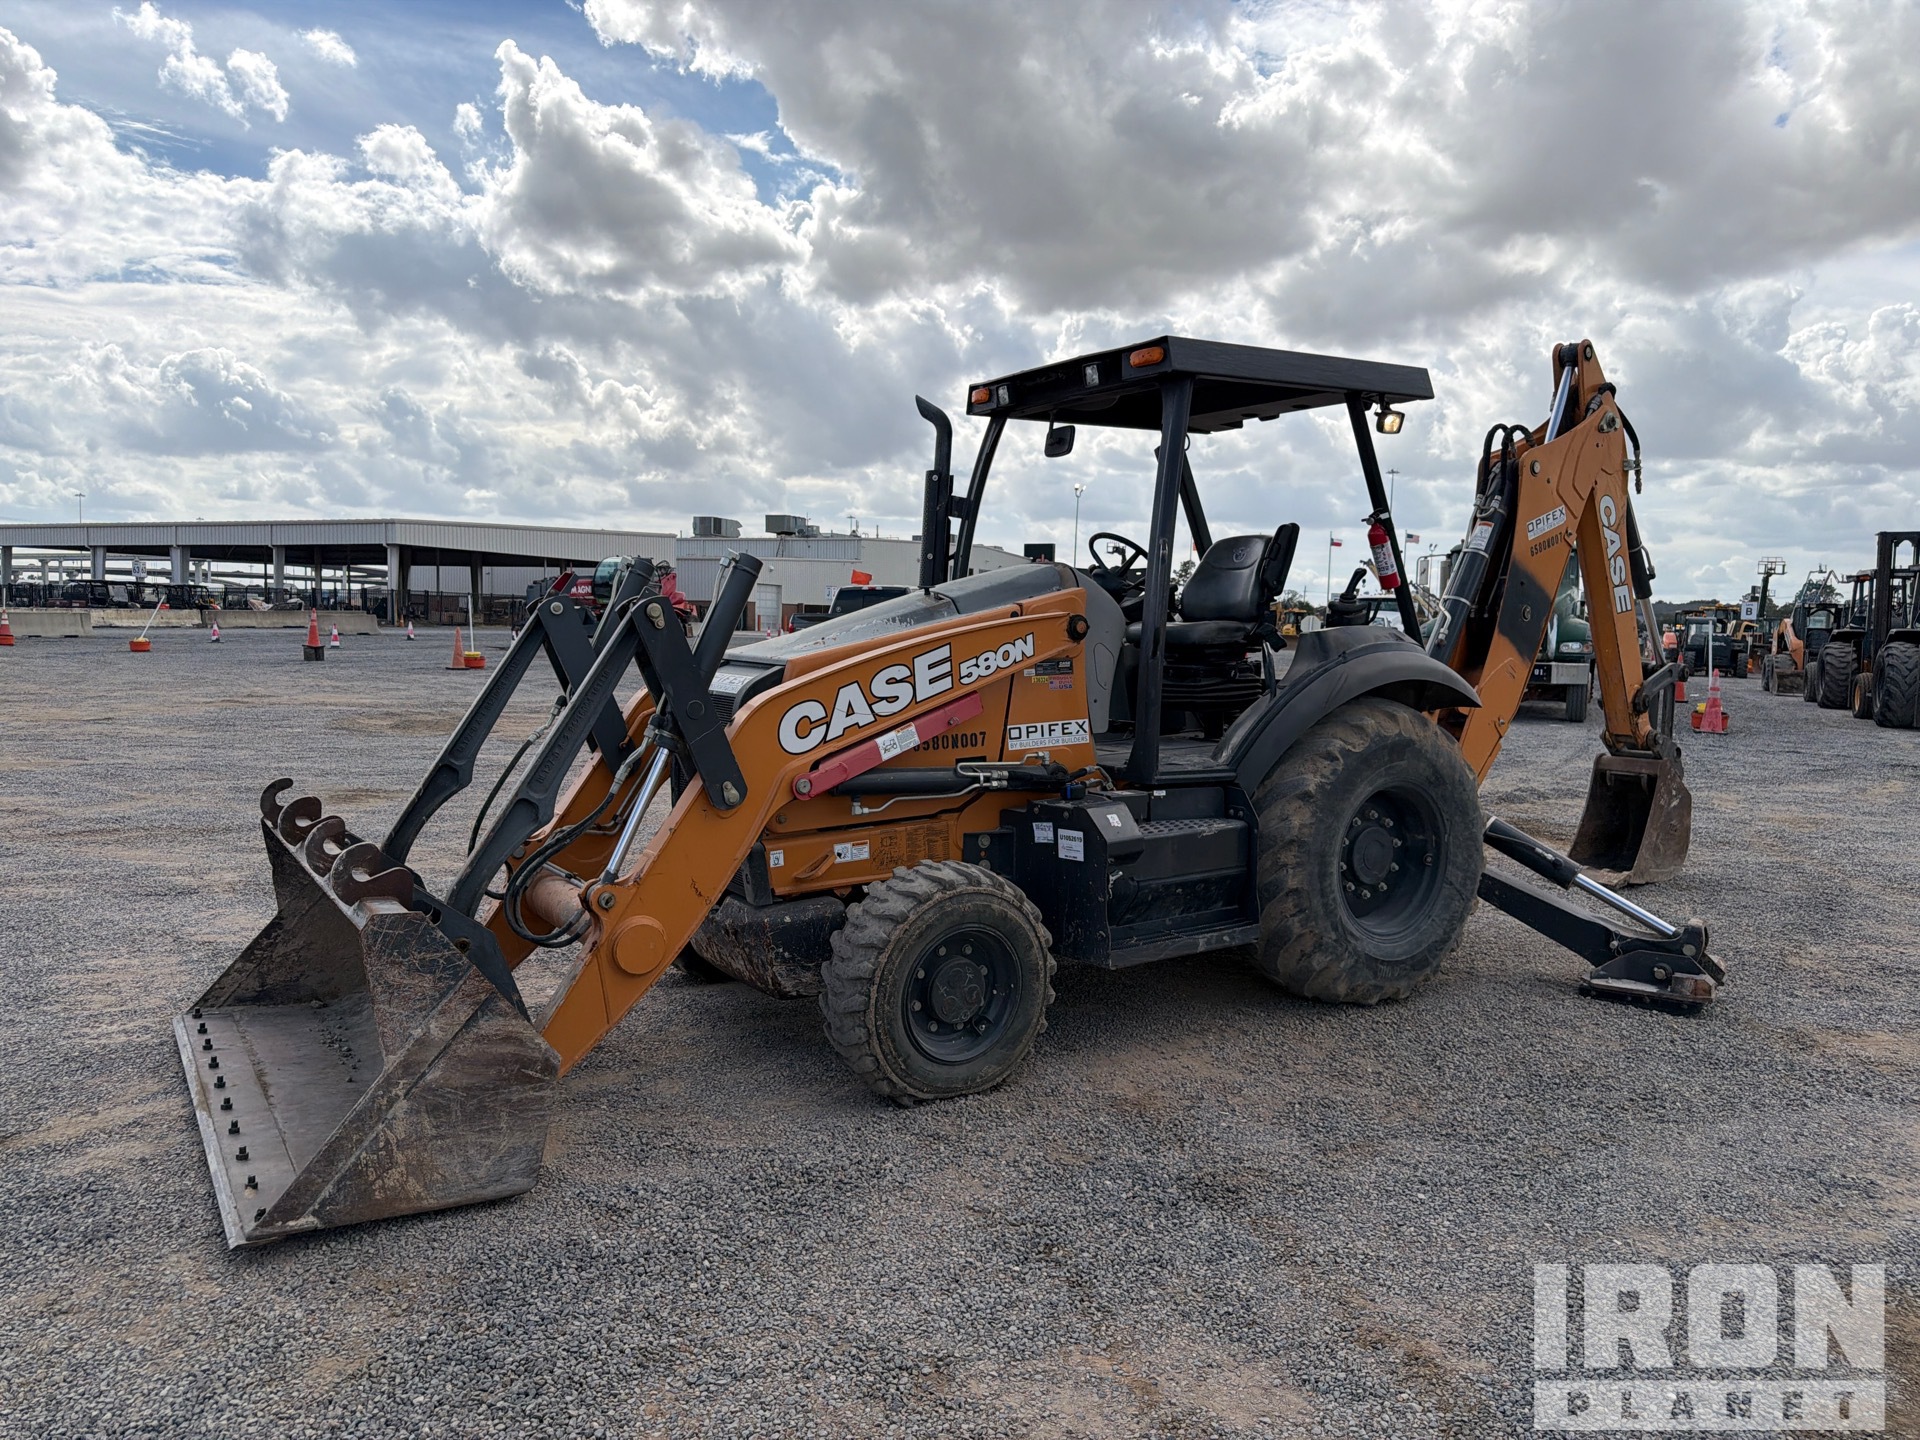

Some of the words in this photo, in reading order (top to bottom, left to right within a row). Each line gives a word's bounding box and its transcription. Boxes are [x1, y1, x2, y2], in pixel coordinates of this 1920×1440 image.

[1527, 507, 1565, 533] OPIFEX
[1599, 494, 1632, 614] CASE
[1745, 607, 1753, 616] B
[959, 632, 1035, 686] 580N
[778, 642, 953, 755] CASE
[1008, 721, 1088, 740] OPIFEX
[1020, 740, 1046, 748] BUILDERS
[1062, 736, 1088, 744] BUILDERS
